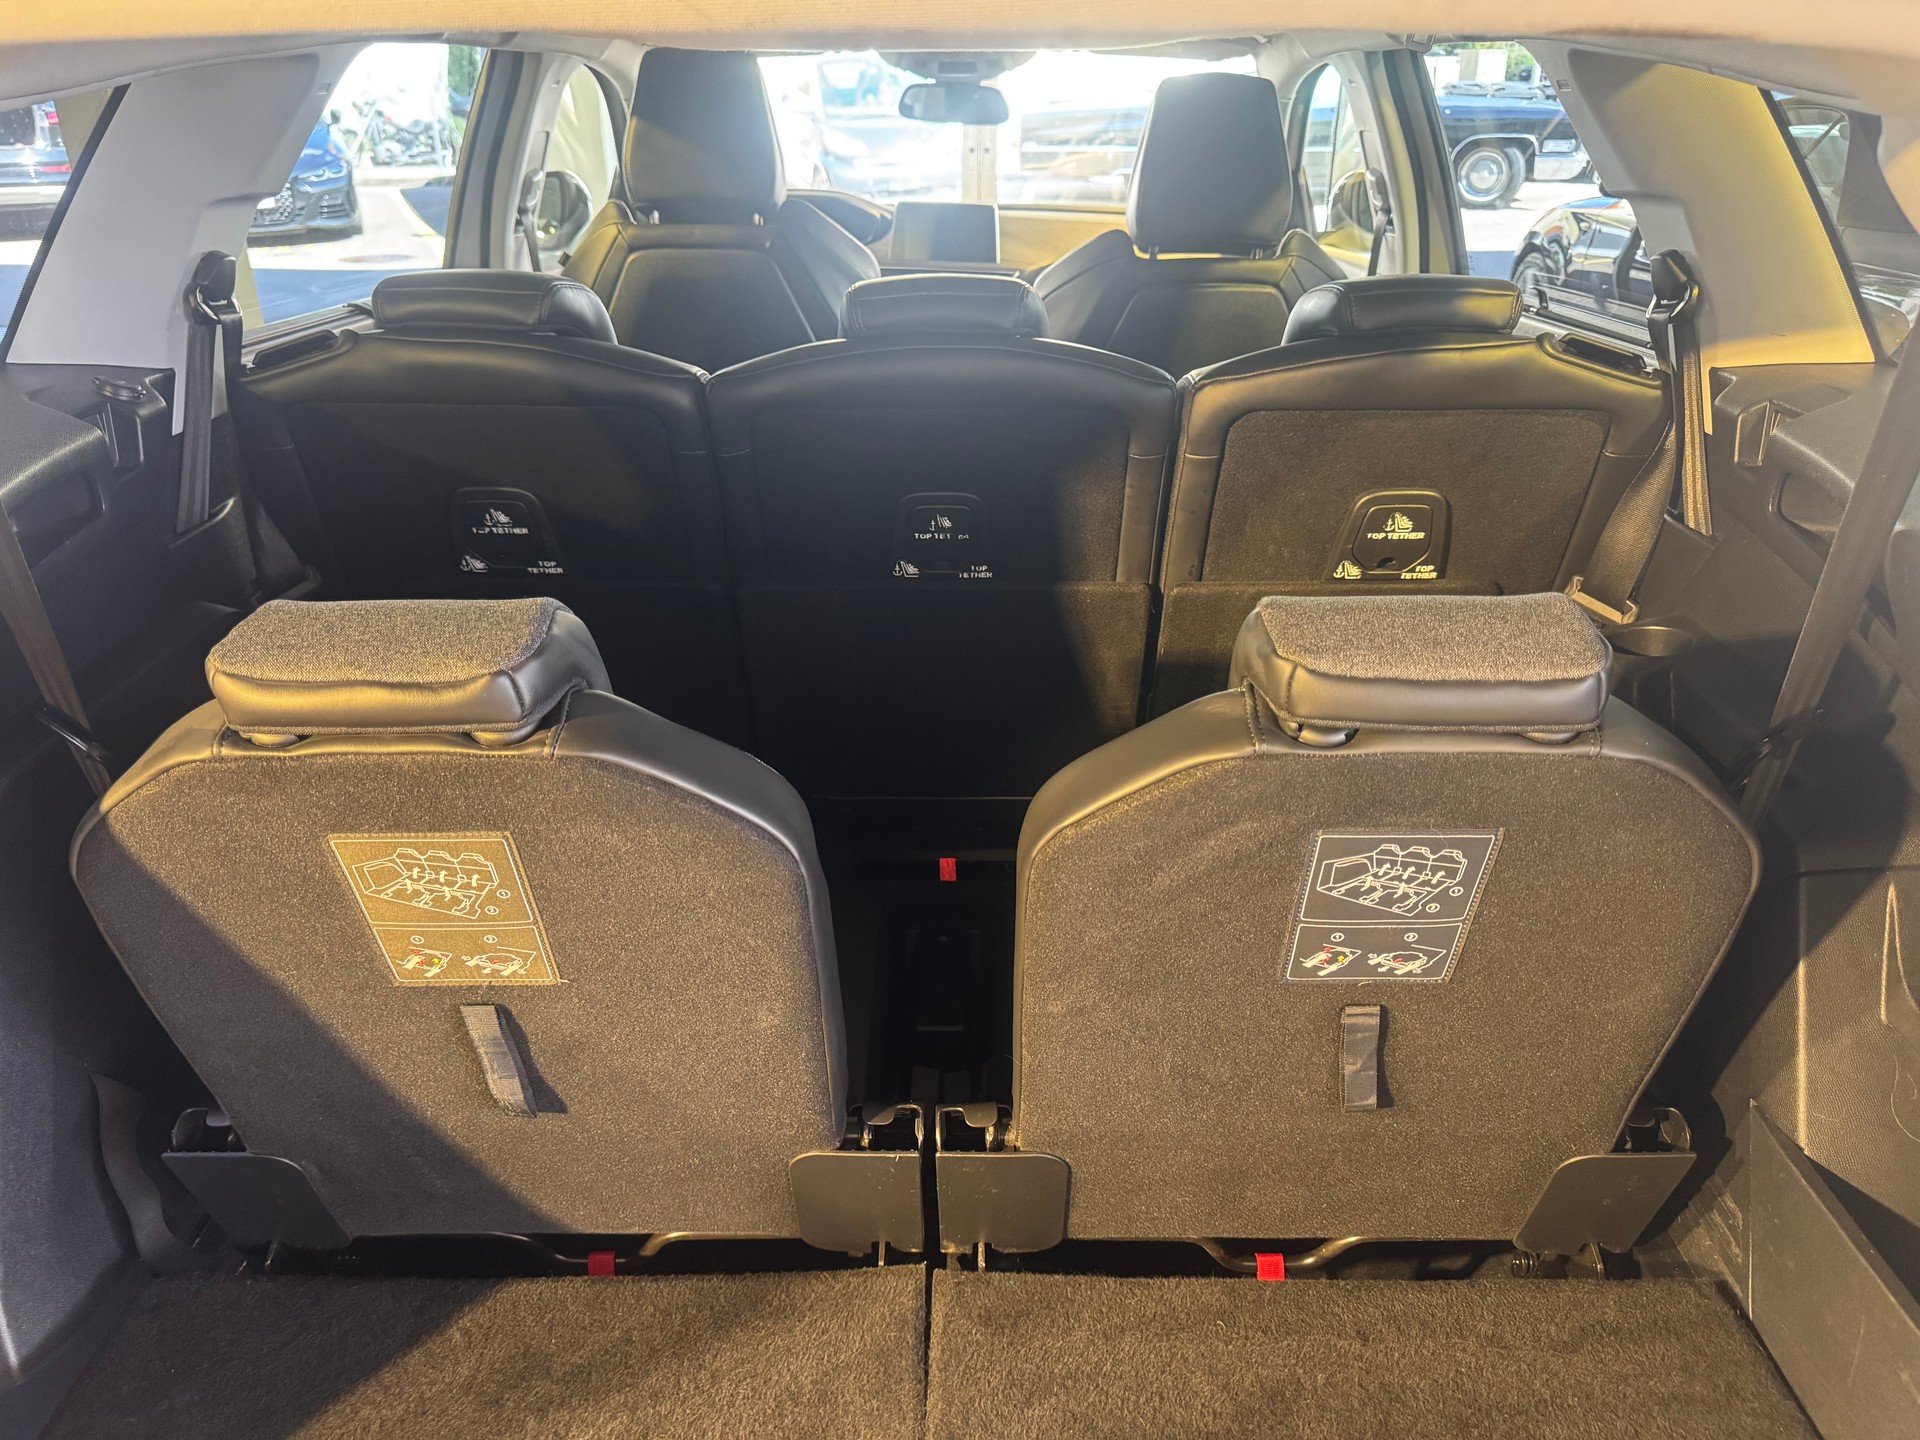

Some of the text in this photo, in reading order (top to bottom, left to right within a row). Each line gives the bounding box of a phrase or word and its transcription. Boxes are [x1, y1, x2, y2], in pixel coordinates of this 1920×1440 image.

[1367, 531, 1426, 540] TOP TETHER
[1400, 572, 1438, 580] TETHER
